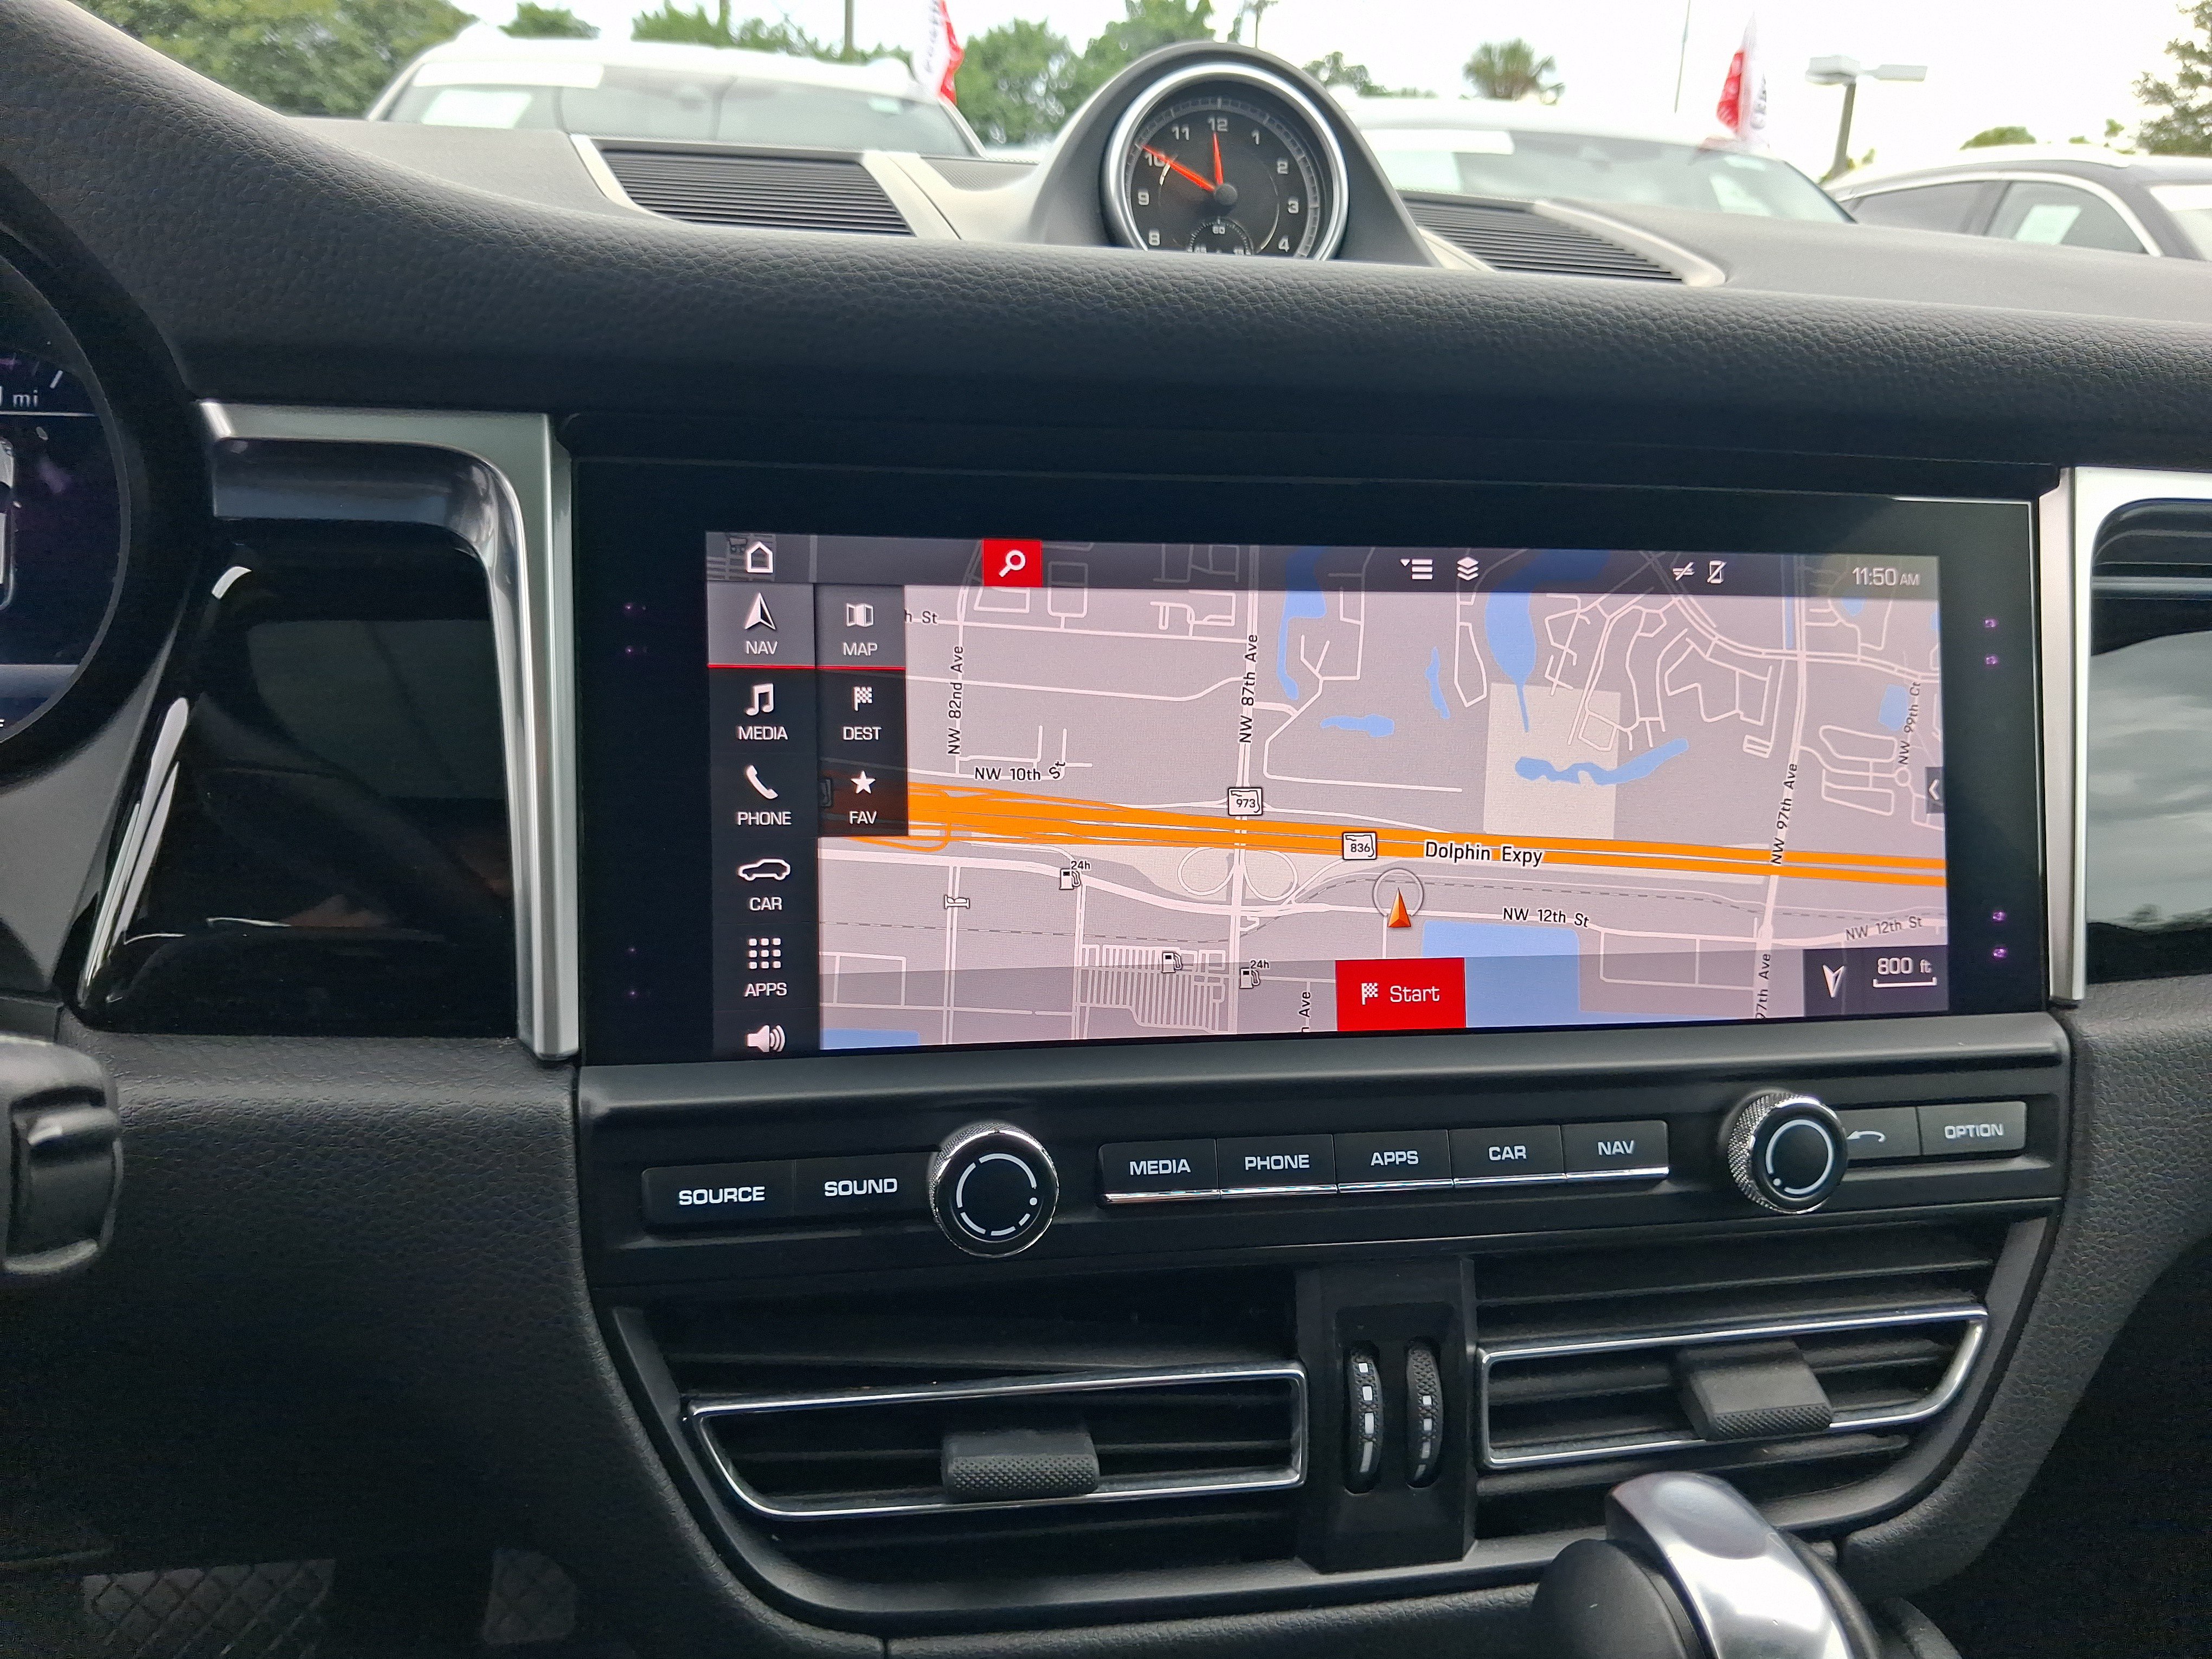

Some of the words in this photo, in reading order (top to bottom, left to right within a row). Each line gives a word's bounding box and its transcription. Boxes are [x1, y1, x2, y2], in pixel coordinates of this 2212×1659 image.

[1207, 117, 1229, 132] 12
[1171, 125, 1190, 141] 11
[1253, 130, 1261, 145] 1
[1277, 159, 1289, 175] 2
[1137, 191, 1149, 206] 9
[1288, 199, 1300, 215] 3
[1148, 230, 1161, 246] 8
[1212, 226, 1225, 234] 60
[1278, 237, 1290, 252] 4
[12, 390, 38, 407] mi
[1853, 567, 1895, 587] 11:50
[1899, 574, 1920, 586] AM
[922, 610, 937, 625] St
[745, 641, 777, 655] NAV
[843, 642, 878, 656] MAP
[1245, 634, 1258, 663] Ave
[950, 646, 963, 673] Ave
[1242, 672, 1256, 706] 87th
[1910, 682, 1921, 696] Ct
[948, 681, 963, 719] 82nd
[1904, 704, 1919, 734] 99th
[738, 726, 788, 740] MEDIA
[843, 727, 882, 740] DEST
[1239, 715, 1252, 743] NW
[948, 728, 961, 755] NW
[1899, 741, 1911, 765] NW
[975, 768, 1001, 781] NW
[1010, 768, 1040, 781] 10th
[1049, 761, 1065, 780] St
[1784, 764, 1798, 789] Ave
[1236, 799, 1256, 808] 973
[738, 812, 792, 825] PHONE
[849, 812, 877, 824] FAV
[1777, 798, 1792, 829] 97th
[1351, 843, 1370, 853] 836
[1425, 842, 1490, 863] Dolphin
[1502, 846, 1542, 867] Expy
[1771, 837, 1785, 864] NW
[1071, 861, 1090, 870] 24h
[749, 897, 782, 911] CAR
[1503, 908, 1529, 921] NW
[1538, 910, 1566, 923] 12th
[1574, 914, 1590, 927] St
[1846, 925, 1869, 940] NW
[1875, 921, 1902, 934] 12th
[1908, 916, 1922, 928] St
[1250, 960, 1270, 969] 24h
[1759, 953, 1771, 979] Ave
[1877, 958, 1913, 974] 800
[1920, 960, 1932, 973] ft
[744, 983, 787, 997] APPS
[1390, 986, 1440, 1002] Start
[1298, 992, 1311, 1018] Ave
[1944, 1123, 2004, 1139] OPTION
[1488, 1145, 1527, 1161] CAR
[1598, 1140, 1635, 1155] NAV
[1245, 1154, 1310, 1171] PHONE
[1371, 1150, 1419, 1167] APPS
[1129, 1159, 1191, 1175] MEDIA
[824, 1178, 898, 1197] SOUND
[679, 1186, 765, 1206] SOURCE
